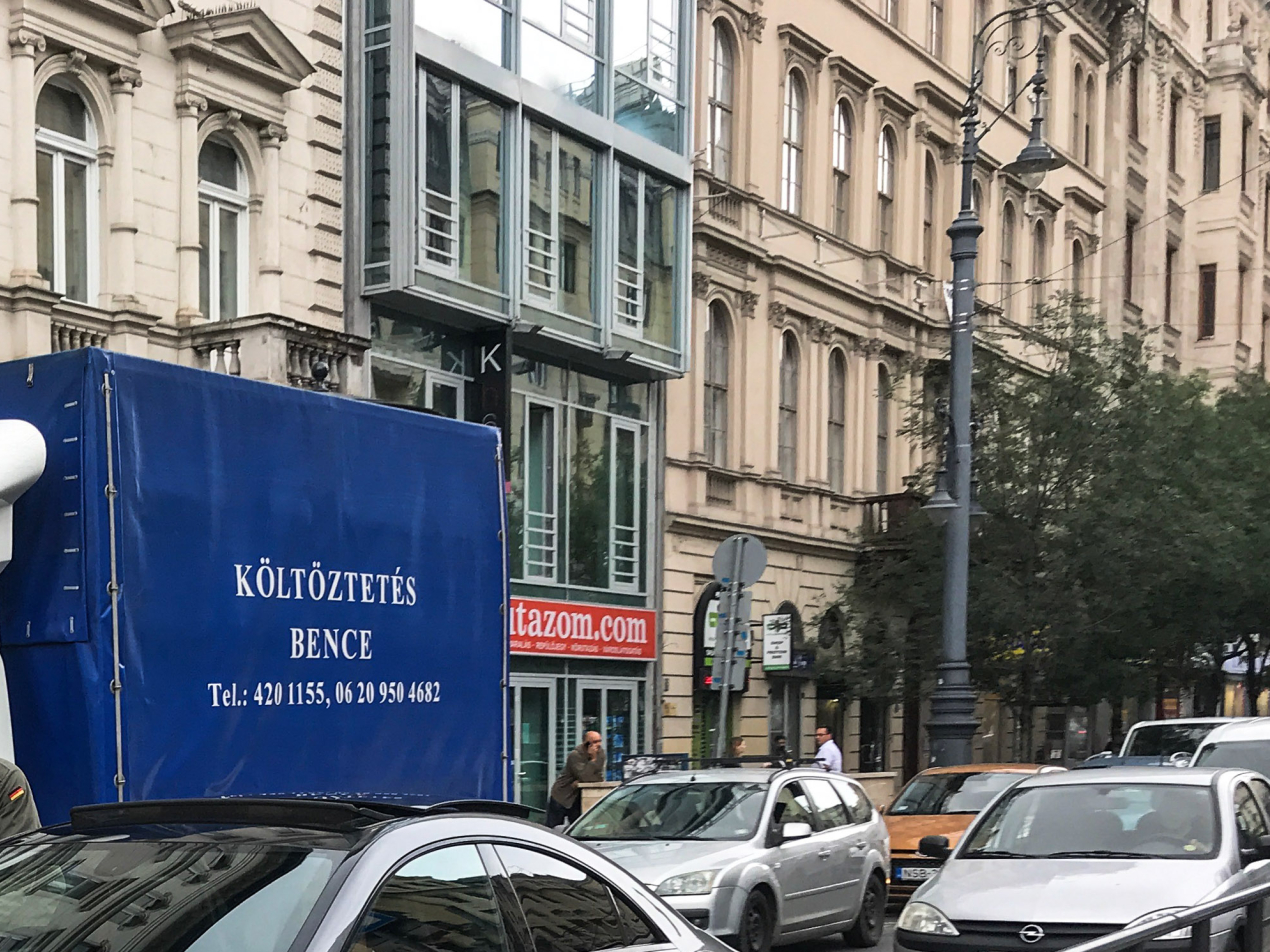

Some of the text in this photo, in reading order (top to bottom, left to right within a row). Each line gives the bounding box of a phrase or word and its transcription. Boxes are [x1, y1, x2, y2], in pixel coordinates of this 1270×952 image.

[233, 557, 417, 606] KÖLTÖZTETÉS
[289, 627, 373, 660] BENCE
[207, 681, 441, 709] Tel.: 420 1155, 06 20 950 4682
